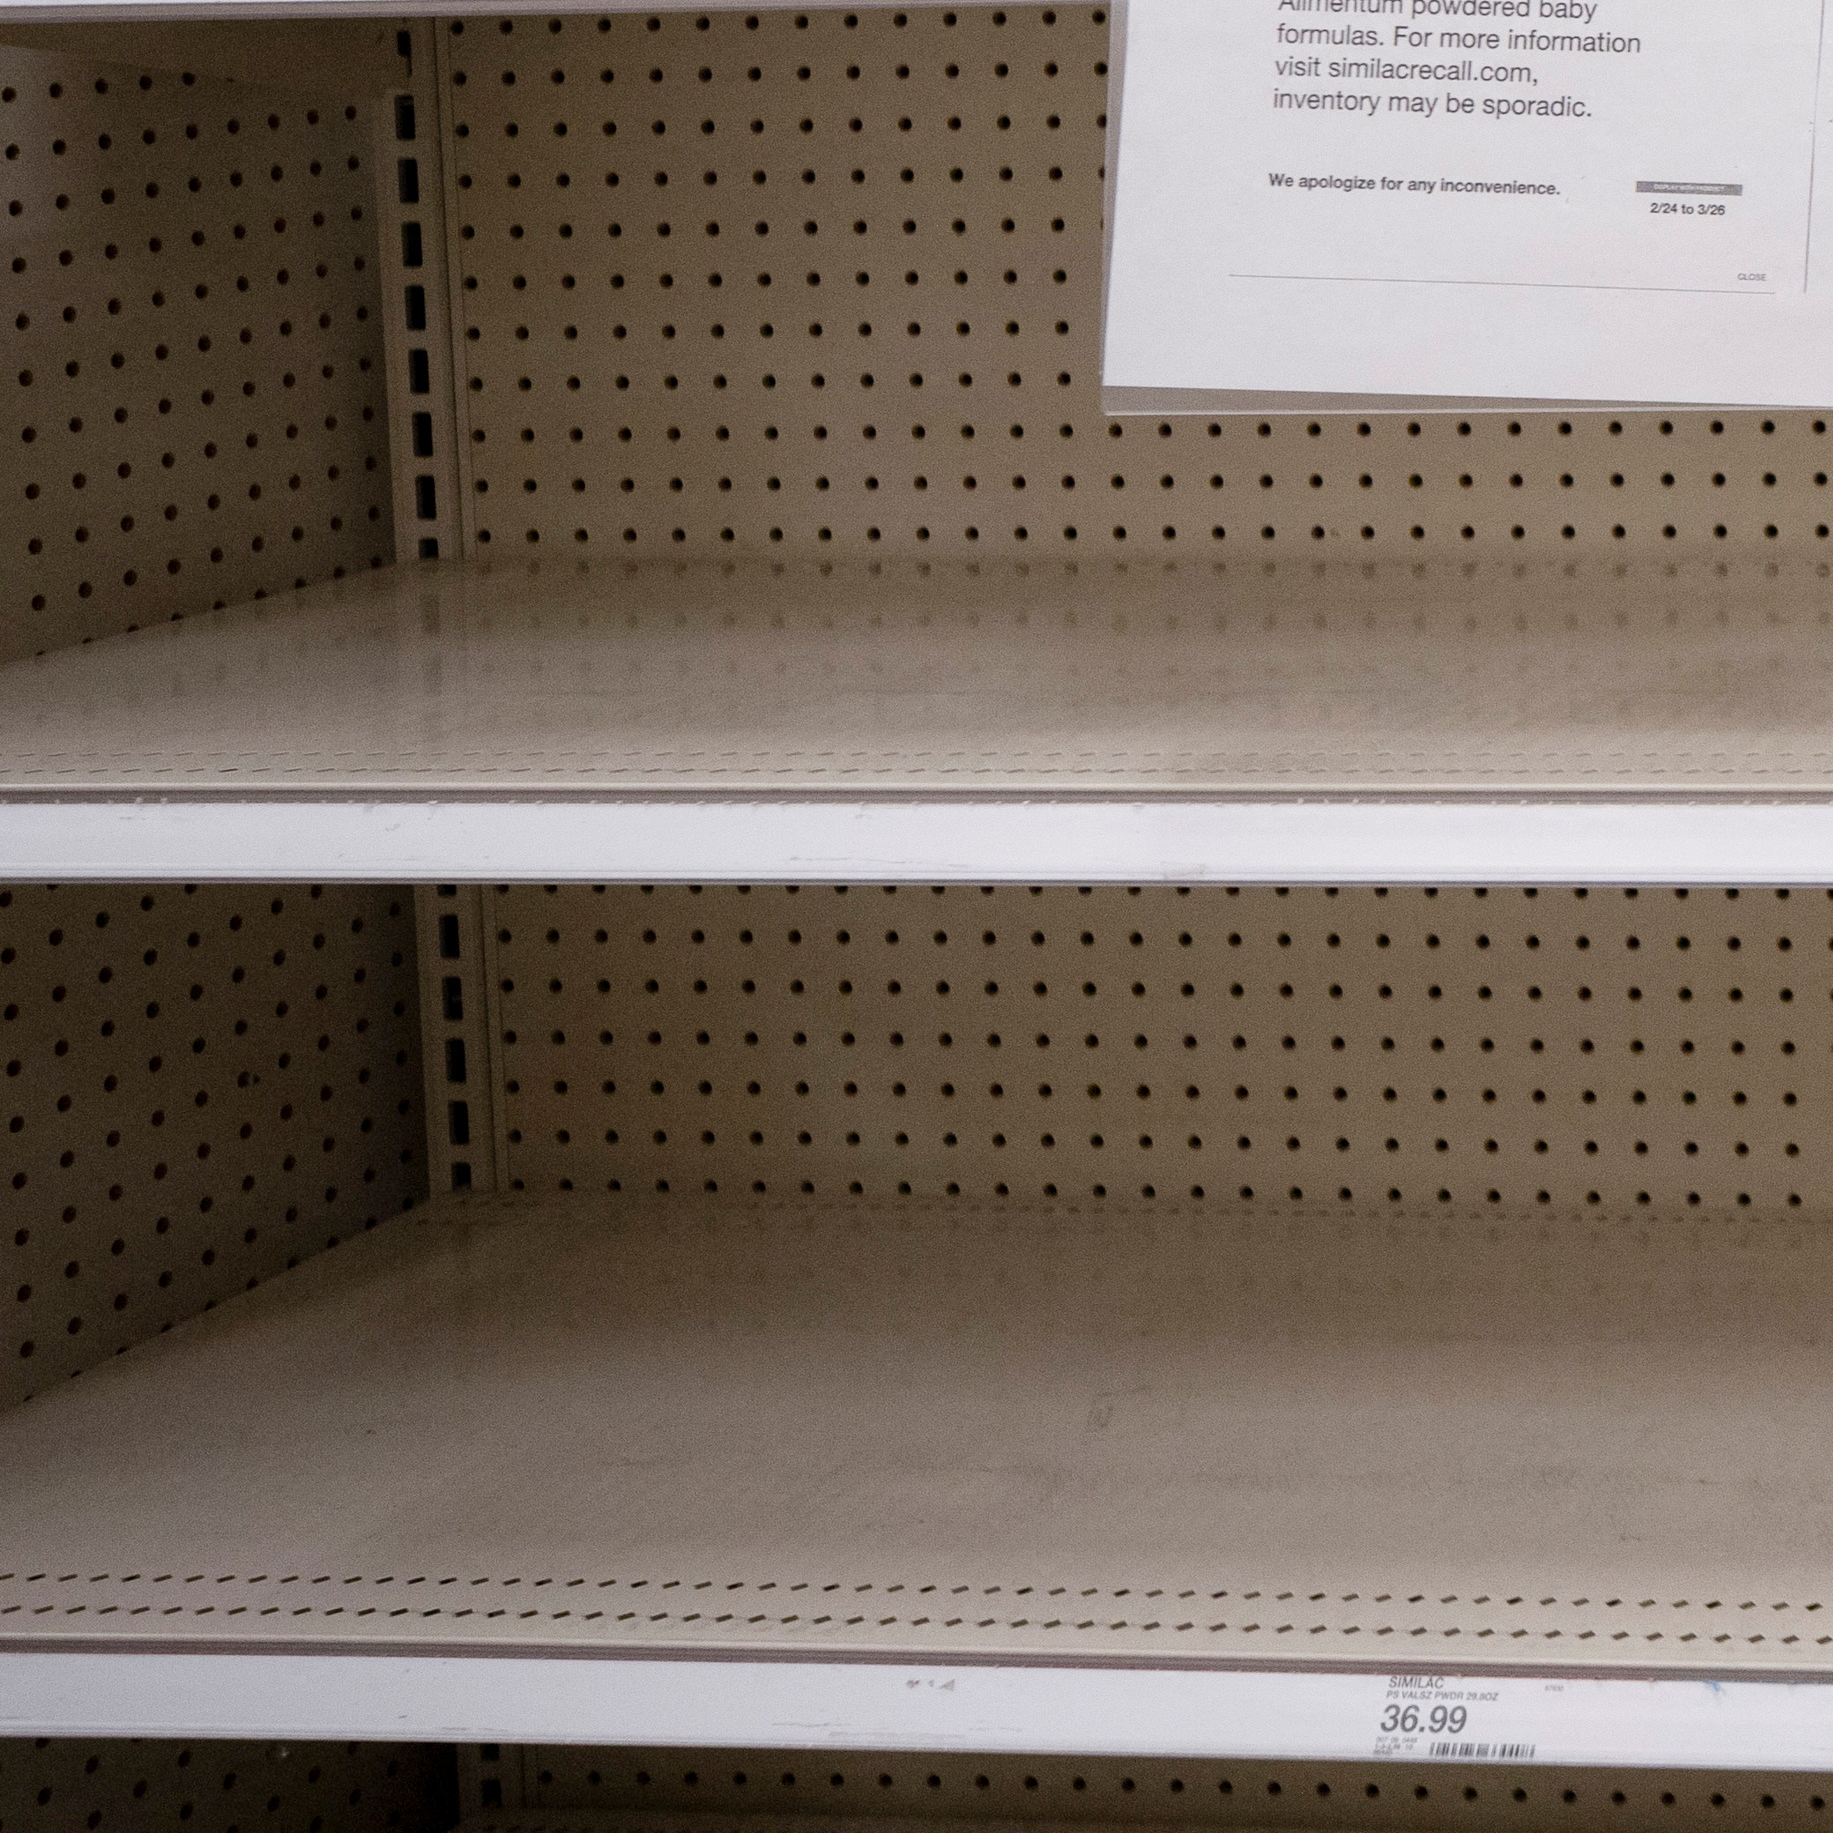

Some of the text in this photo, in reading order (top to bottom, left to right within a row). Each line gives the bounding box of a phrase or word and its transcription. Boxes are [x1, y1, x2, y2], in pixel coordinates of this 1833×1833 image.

[1277, 22, 1641, 53] formulas. For more information
[1275, 56, 1538, 86] visit similacrecall.com,
[1274, 88, 1591, 120] inventory may be sporadic.
[1268, 173, 1560, 195] We apologize for any inconvenience.
[1651, 203, 1725, 215] 2/24 to 3/26
[1737, 273, 1766, 281] CLOSE
[1388, 1676, 1444, 1688] SIMILAC
[1380, 1704, 1467, 1733] 36.99
